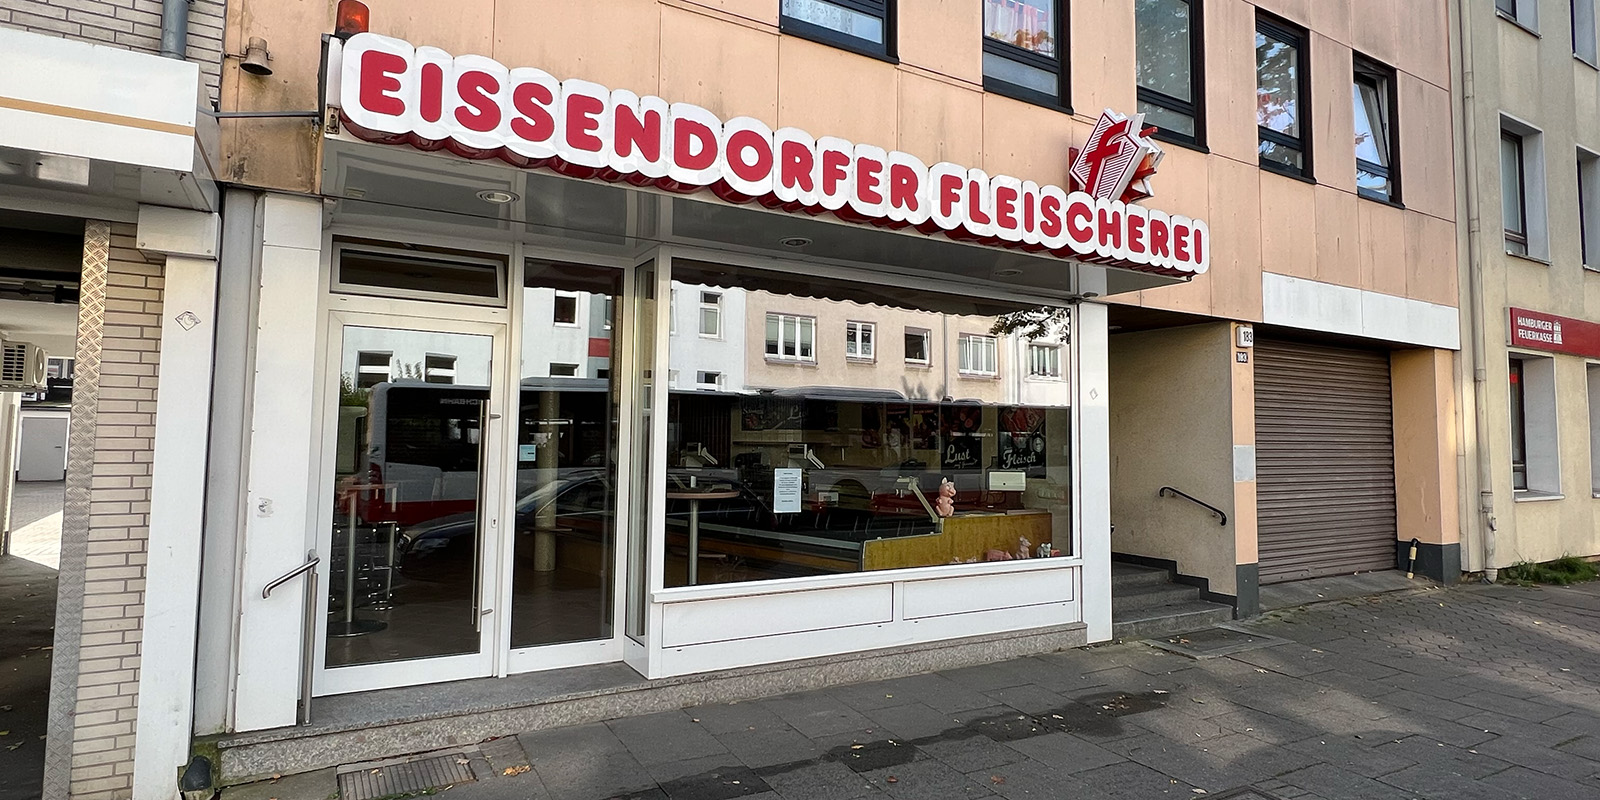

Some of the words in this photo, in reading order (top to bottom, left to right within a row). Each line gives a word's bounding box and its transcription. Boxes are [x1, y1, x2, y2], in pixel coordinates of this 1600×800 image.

[360, 49, 918, 212] EISSENDORFER
[940, 174, 1203, 265] FLEISCHEREI
[1517, 316, 1552, 331] HAMBURGER
[1243, 331, 1252, 342] 183
[1518, 329, 1553, 343] FEUERKASSE
[944, 444, 971, 464] Lust
[1002, 448, 1036, 469] Fleisch
